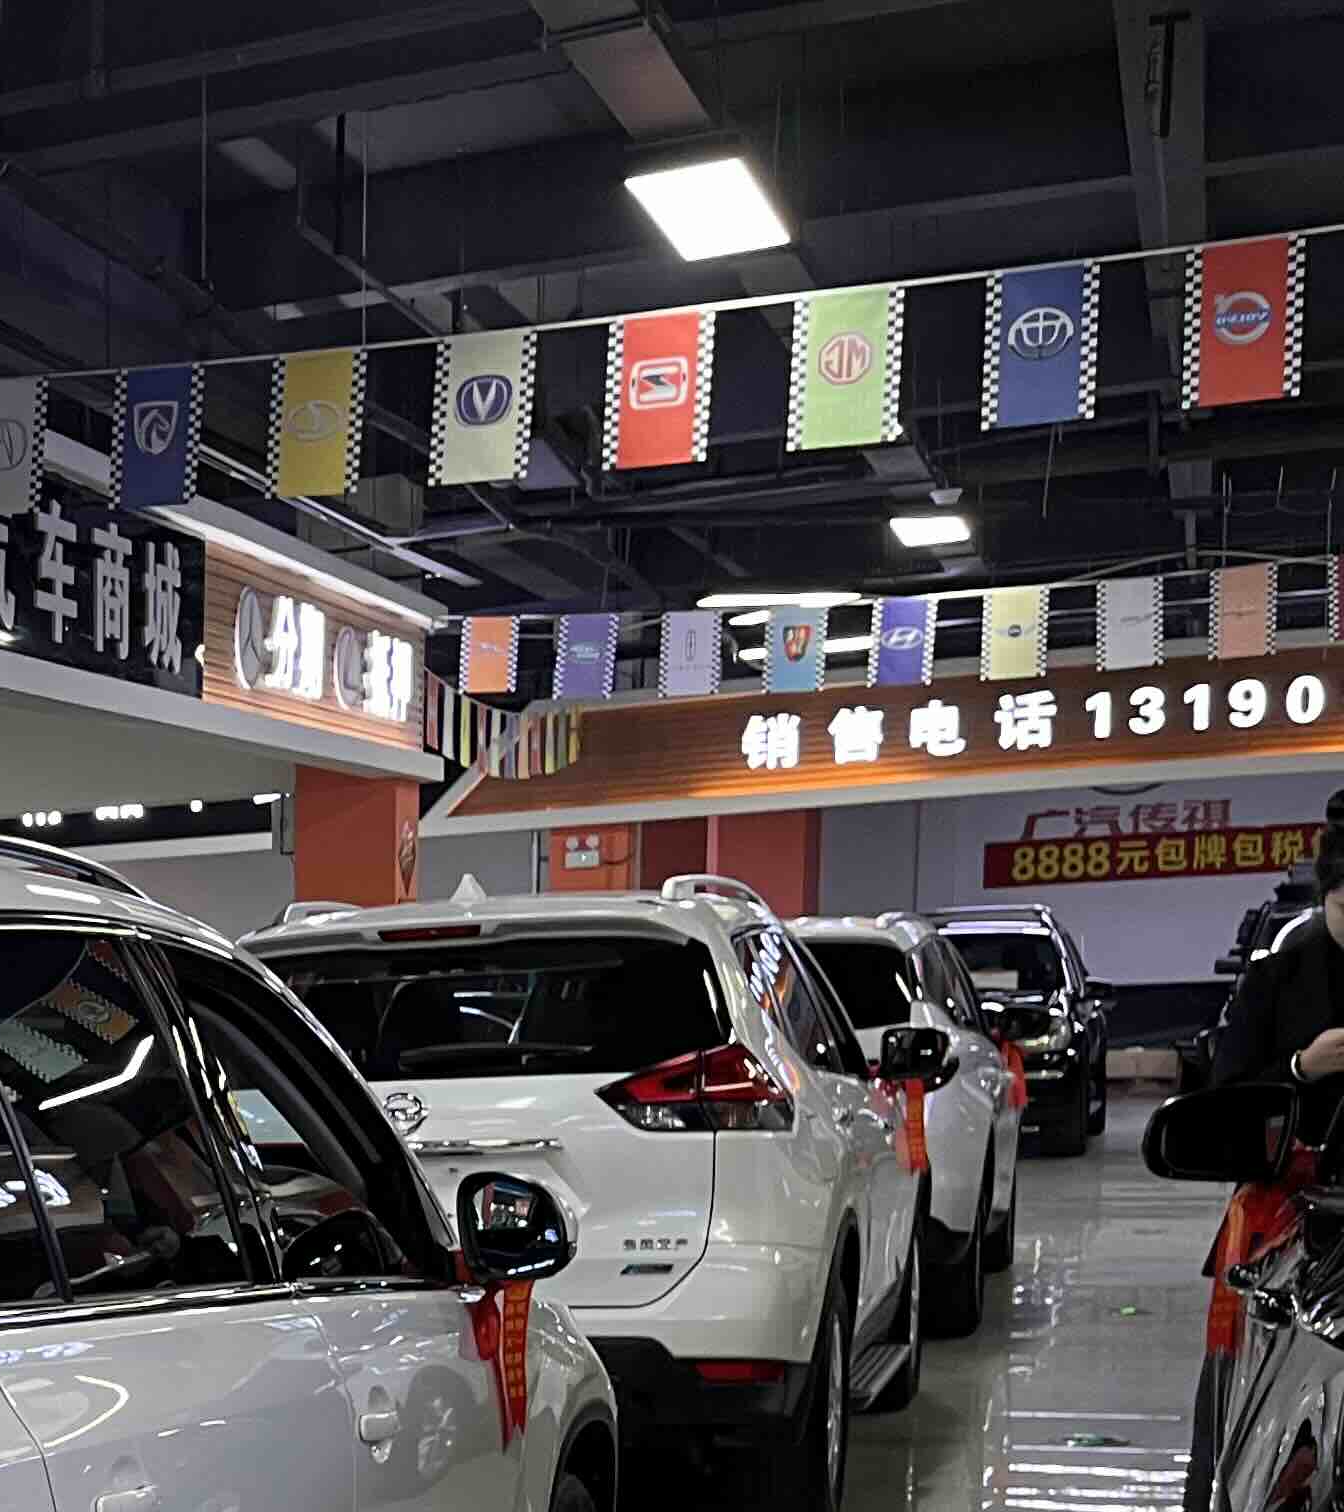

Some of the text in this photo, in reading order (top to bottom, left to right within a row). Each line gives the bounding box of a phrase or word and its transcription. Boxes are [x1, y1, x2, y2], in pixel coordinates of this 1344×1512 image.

[741, 674, 1325, 771] 销售电话 13190
[1011, 829, 1321, 881] 8888元包牌包税
